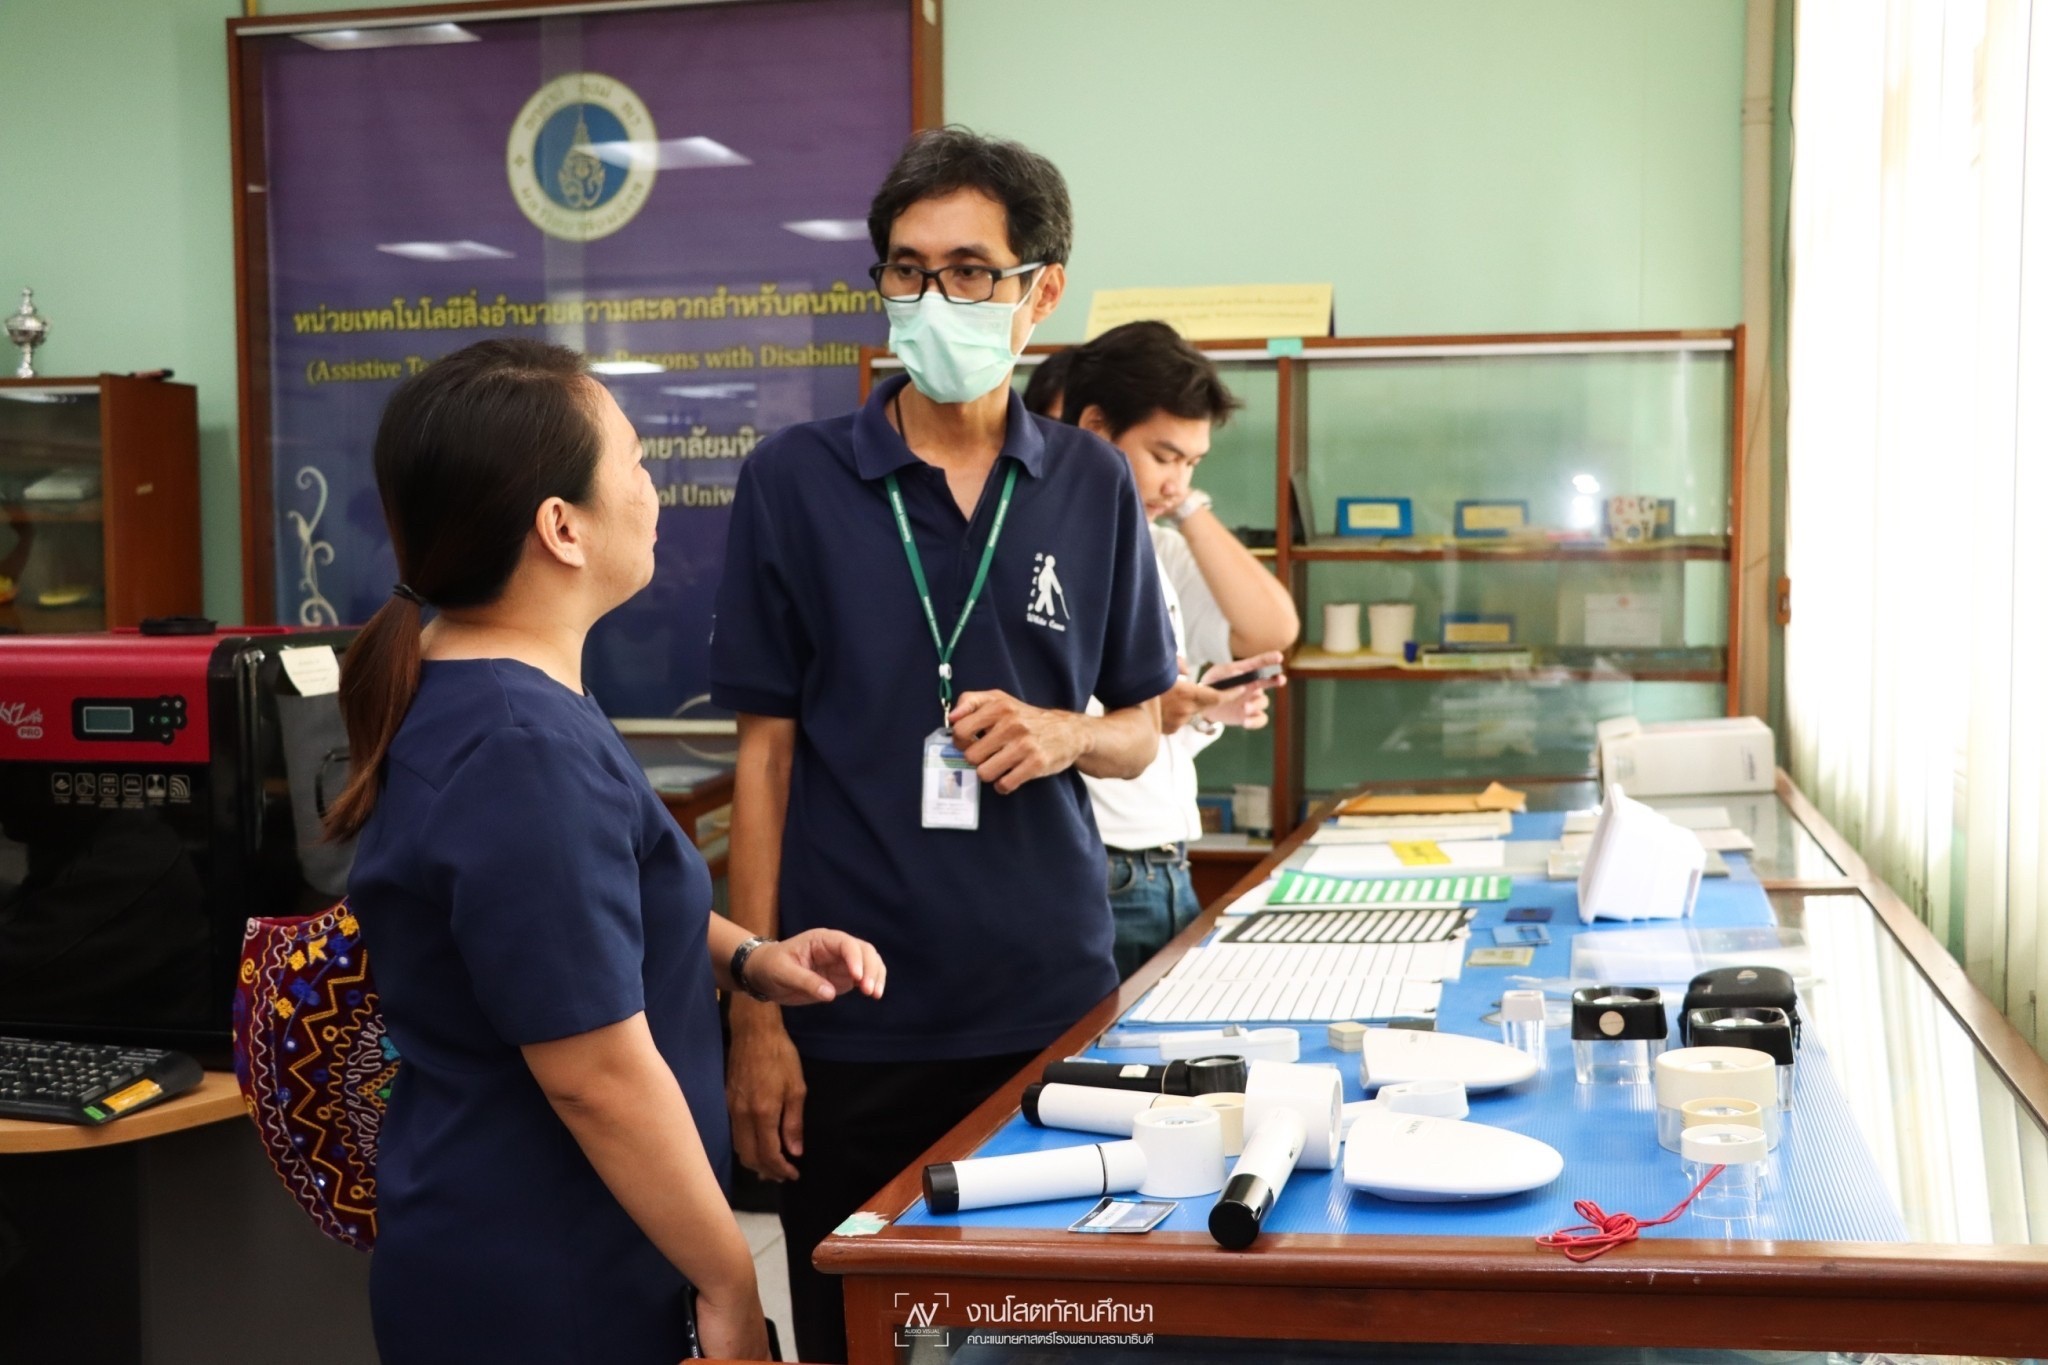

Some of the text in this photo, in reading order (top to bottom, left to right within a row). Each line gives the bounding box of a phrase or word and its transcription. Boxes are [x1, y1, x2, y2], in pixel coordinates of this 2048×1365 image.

[293, 281, 883, 332] หน่วยเทคโนโลยีสิ่งอำนวยความสะดวกสำหรับคนพิกา
[307, 359, 401, 385] (Assistive
[704, 345, 754, 369] with
[760, 342, 860, 368] Disabiliti
